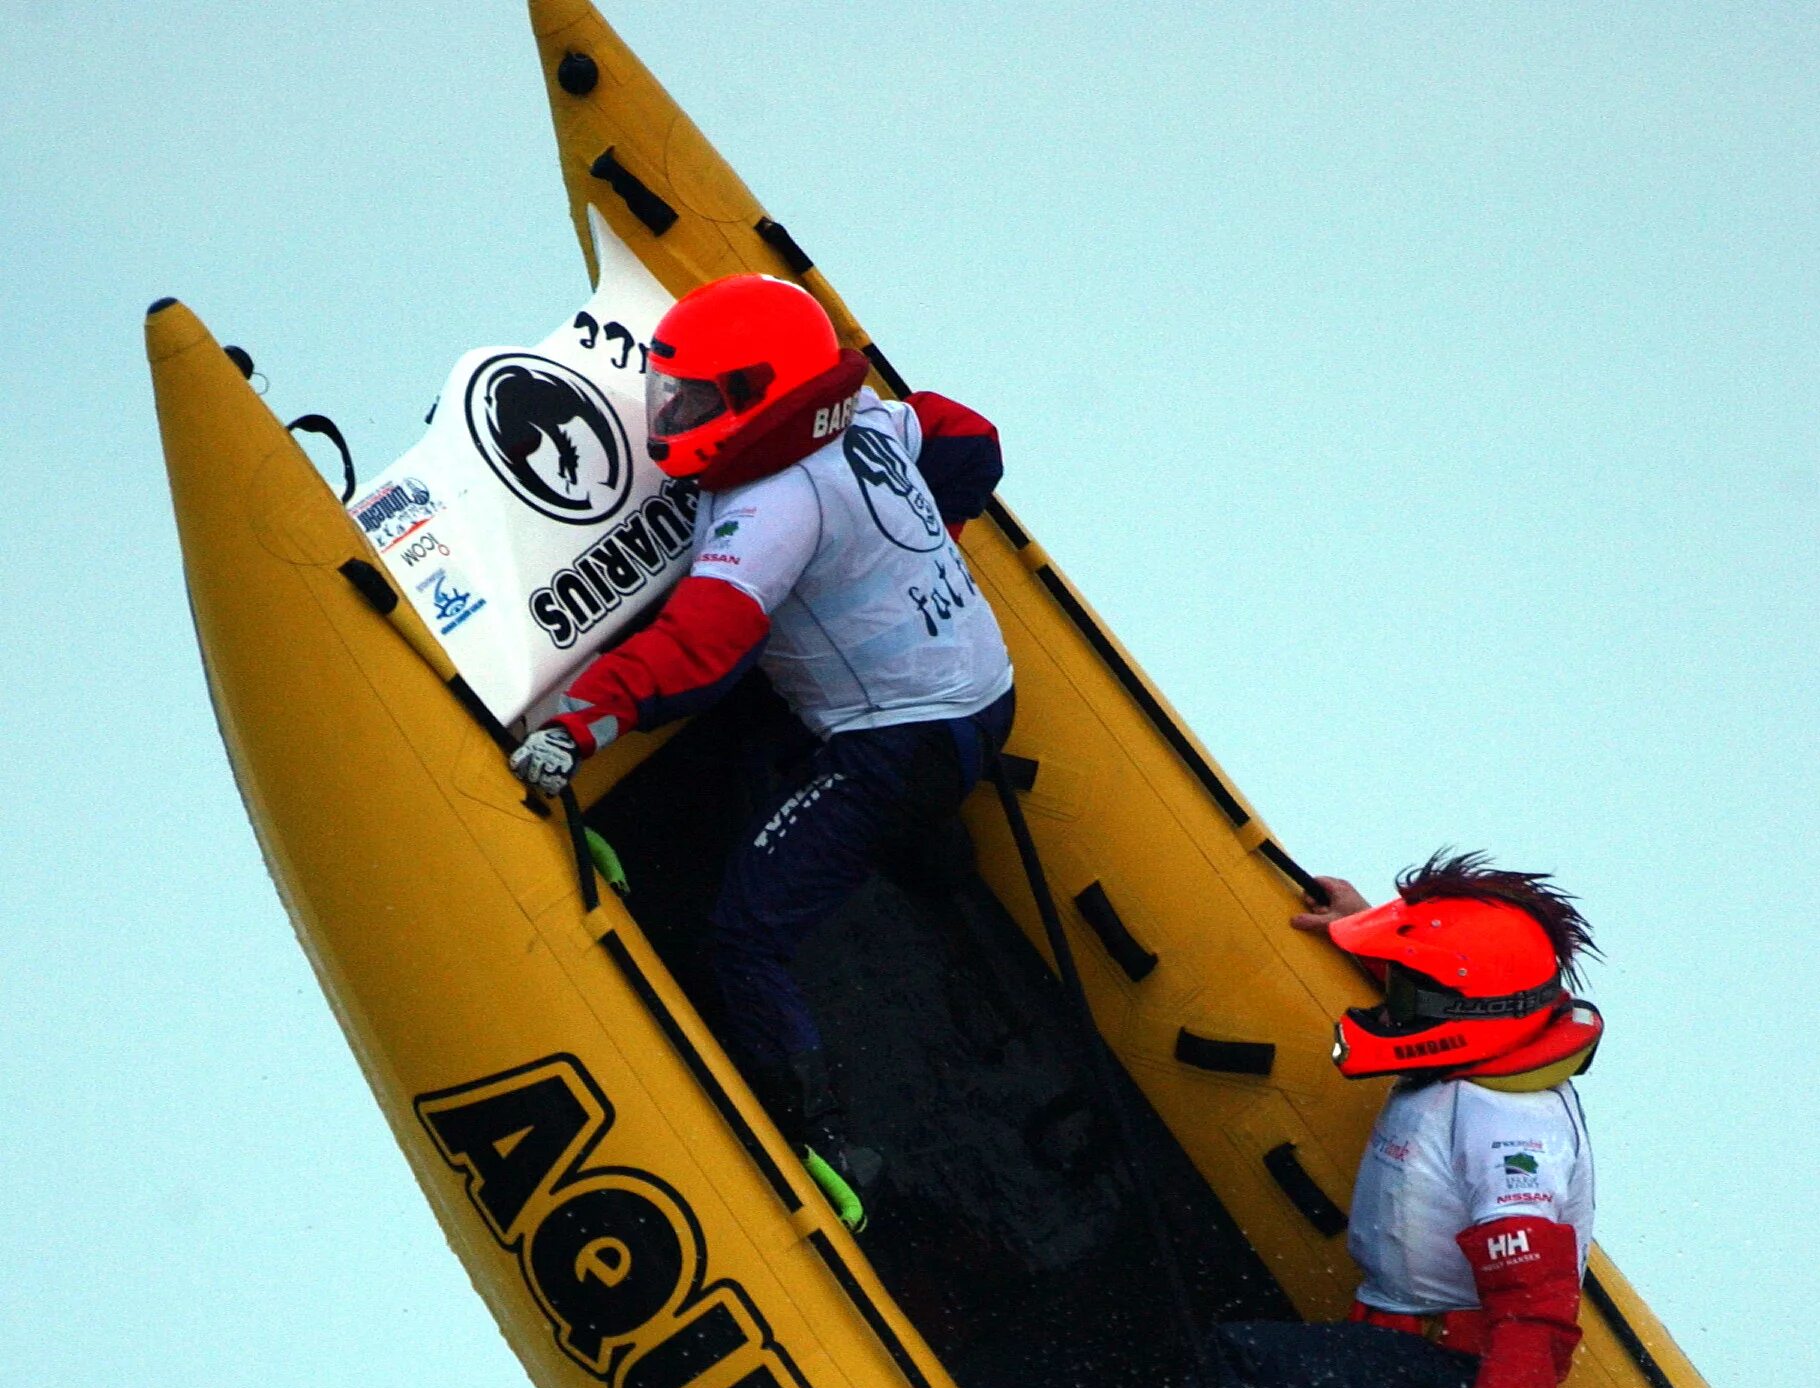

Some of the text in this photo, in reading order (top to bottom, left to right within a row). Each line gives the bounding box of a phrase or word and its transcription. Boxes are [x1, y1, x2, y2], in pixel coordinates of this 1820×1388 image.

[529, 479, 698, 650] QUARIUS
[1496, 1192, 1553, 1205] NISSAN
[1487, 1229, 1530, 1261] HH
